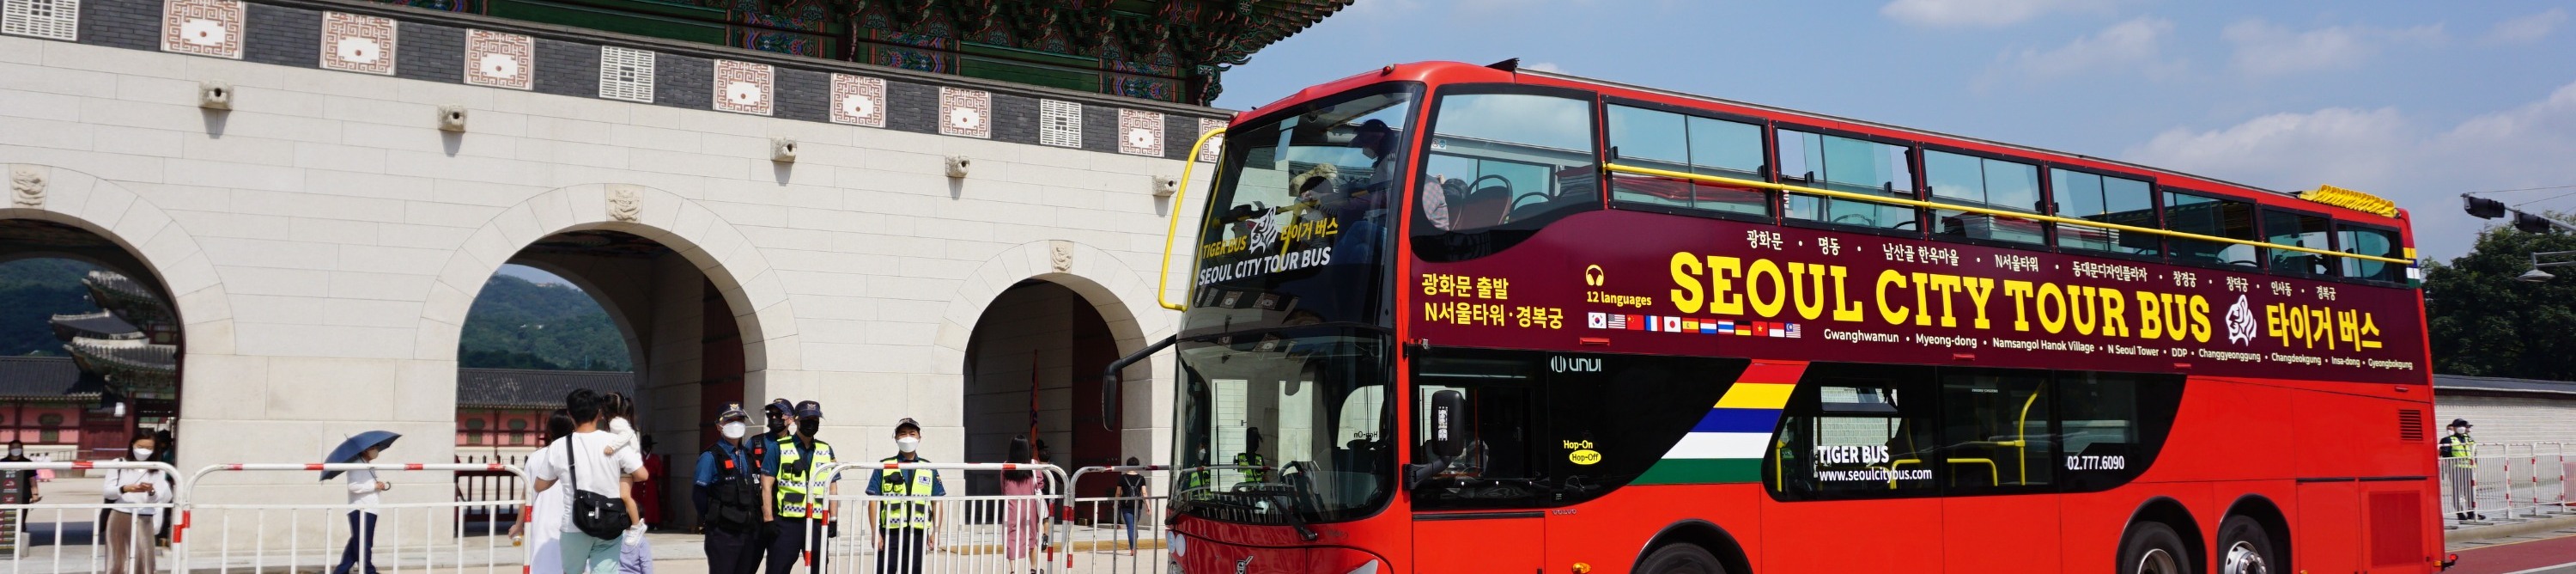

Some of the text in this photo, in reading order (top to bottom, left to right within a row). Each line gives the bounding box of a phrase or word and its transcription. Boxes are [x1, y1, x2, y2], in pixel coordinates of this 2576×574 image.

[1279, 217, 1339, 242] 타이거 버스
[1202, 235, 1248, 259] TIGER BUS
[1199, 247, 1332, 286] SEOUL CITY TOUR BUS
[1747, 229, 2336, 301] 광화문 명동 남산골 한옥마을 N서울타워 동대문디자인플라자 창경궁 창덕궁 인사동 경복궁
[1422, 273, 1509, 300] 광화문 출발
[1670, 251, 2212, 343] SEOUL CITY TOUR BUS
[1587, 290, 1652, 308] 12 languages
[2266, 302, 2383, 352] 타이거 버스
[1824, 328, 2413, 369] Gwanghwamun Myeong-dong Namsangol Hanok Village N Seoul Tower DDP Changgyeonggung Changdeokgung Insa-dong Gyeongbokgung
[1563, 439, 1594, 450] Hop-On
[1817, 445, 1890, 464] TIGER BUS
[1571, 453, 1599, 462] Hop-Off
[2067, 455, 2125, 470] 02.777.6090
[1820, 467, 1932, 483] www.seoulcitybus.com
